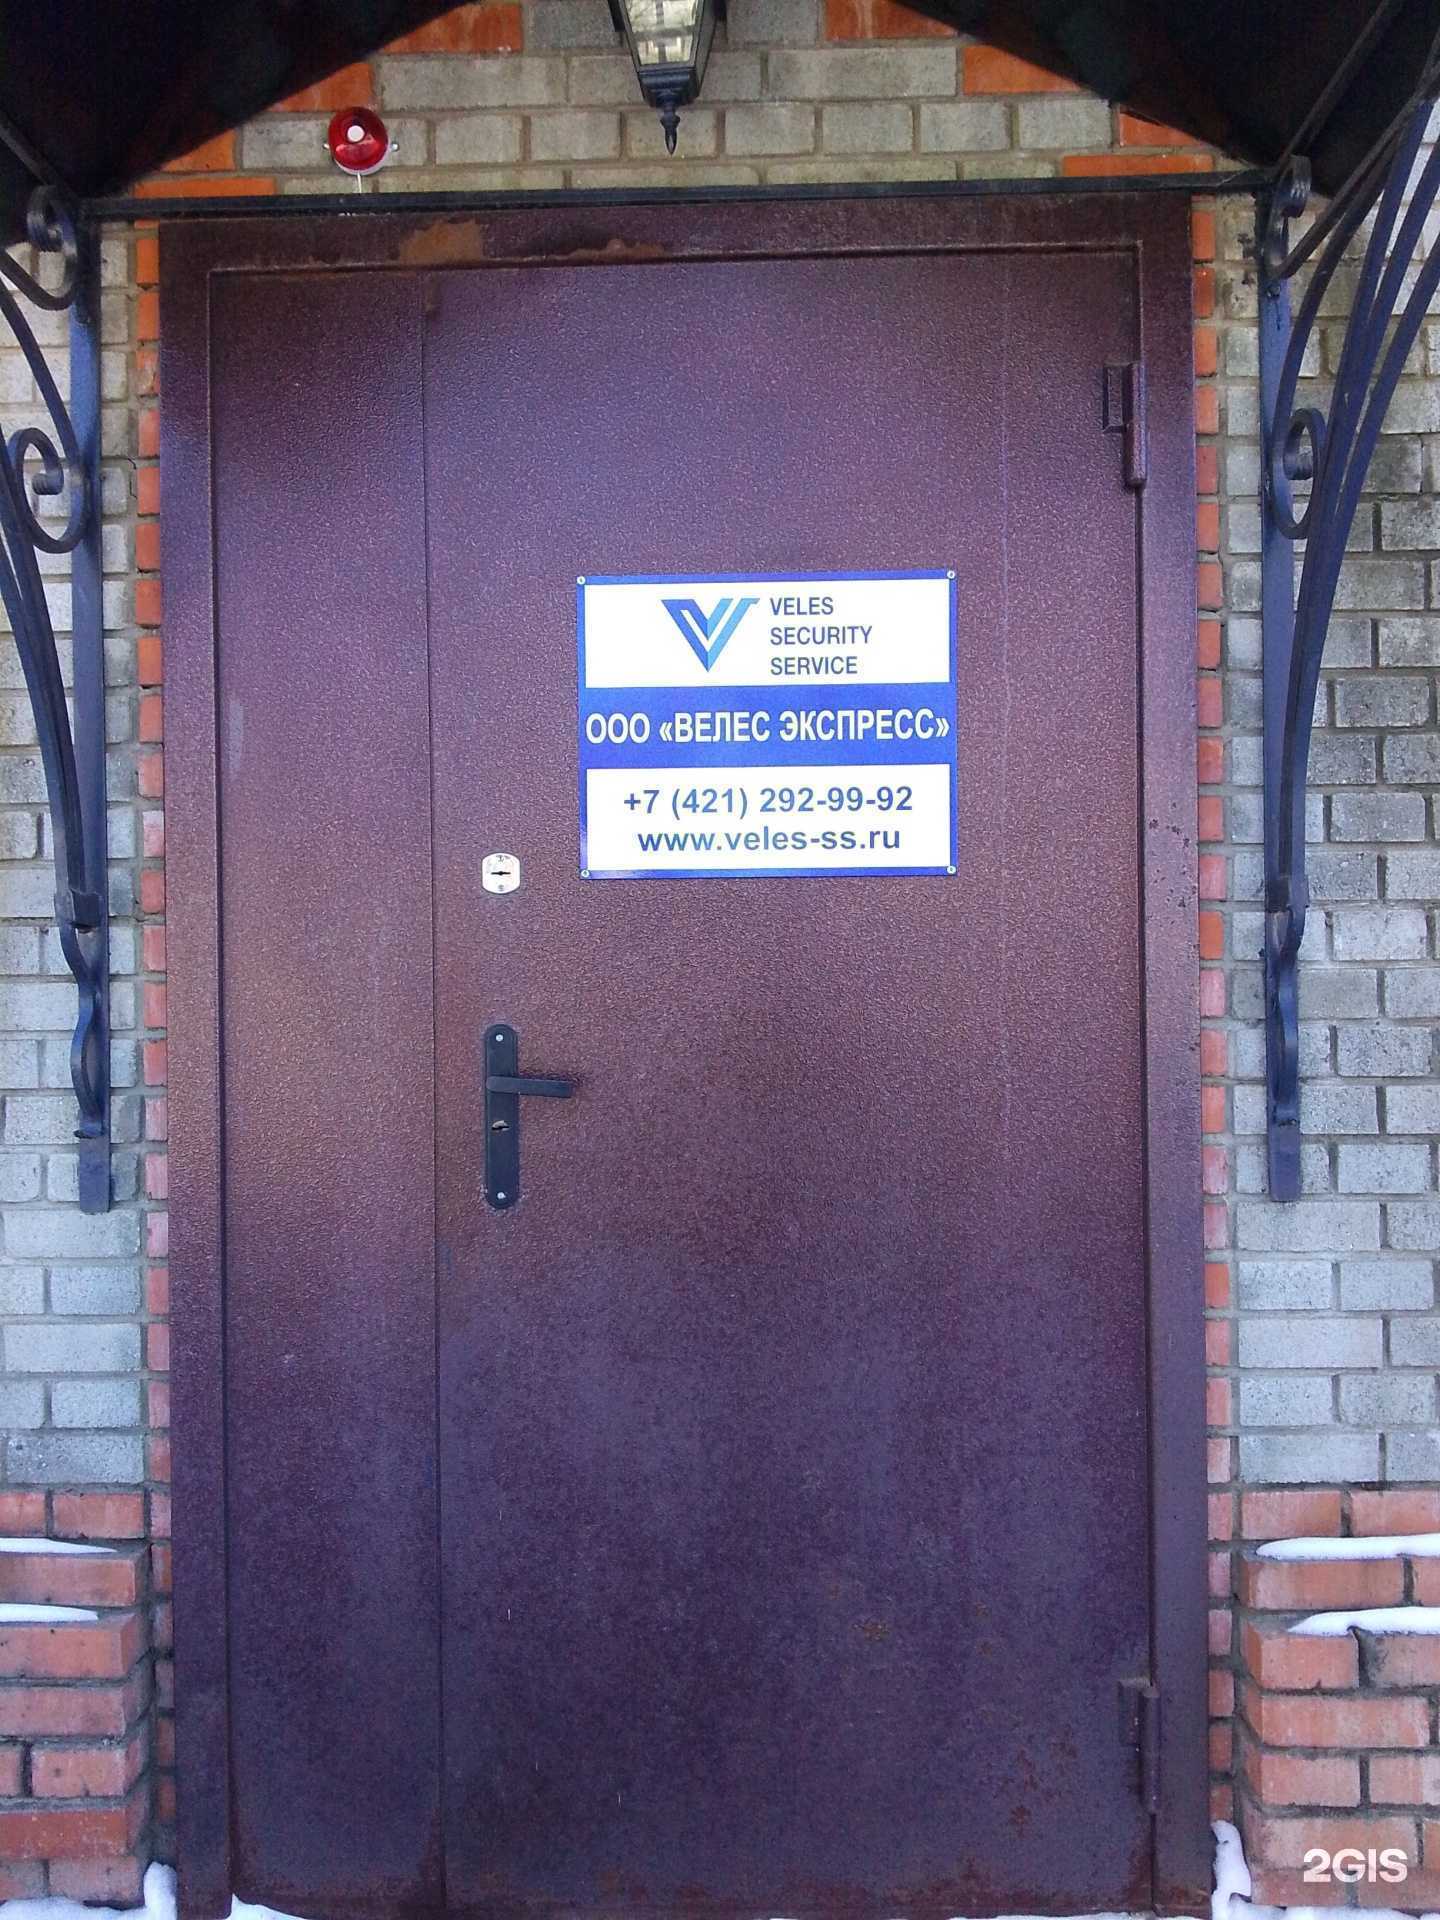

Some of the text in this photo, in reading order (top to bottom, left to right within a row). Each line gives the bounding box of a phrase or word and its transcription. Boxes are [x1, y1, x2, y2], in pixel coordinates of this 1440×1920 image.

[769, 597, 834, 616] VELES
[769, 626, 872, 646] SECURITY
[769, 656, 858, 676] SERVICE
[585, 707, 951, 744] ООО «ВЕЛЕС ЭКСПРЕСС»
[623, 785, 914, 820] +7 (421) 292-99-92
[637, 826, 901, 852] www.veles-ss.ru
